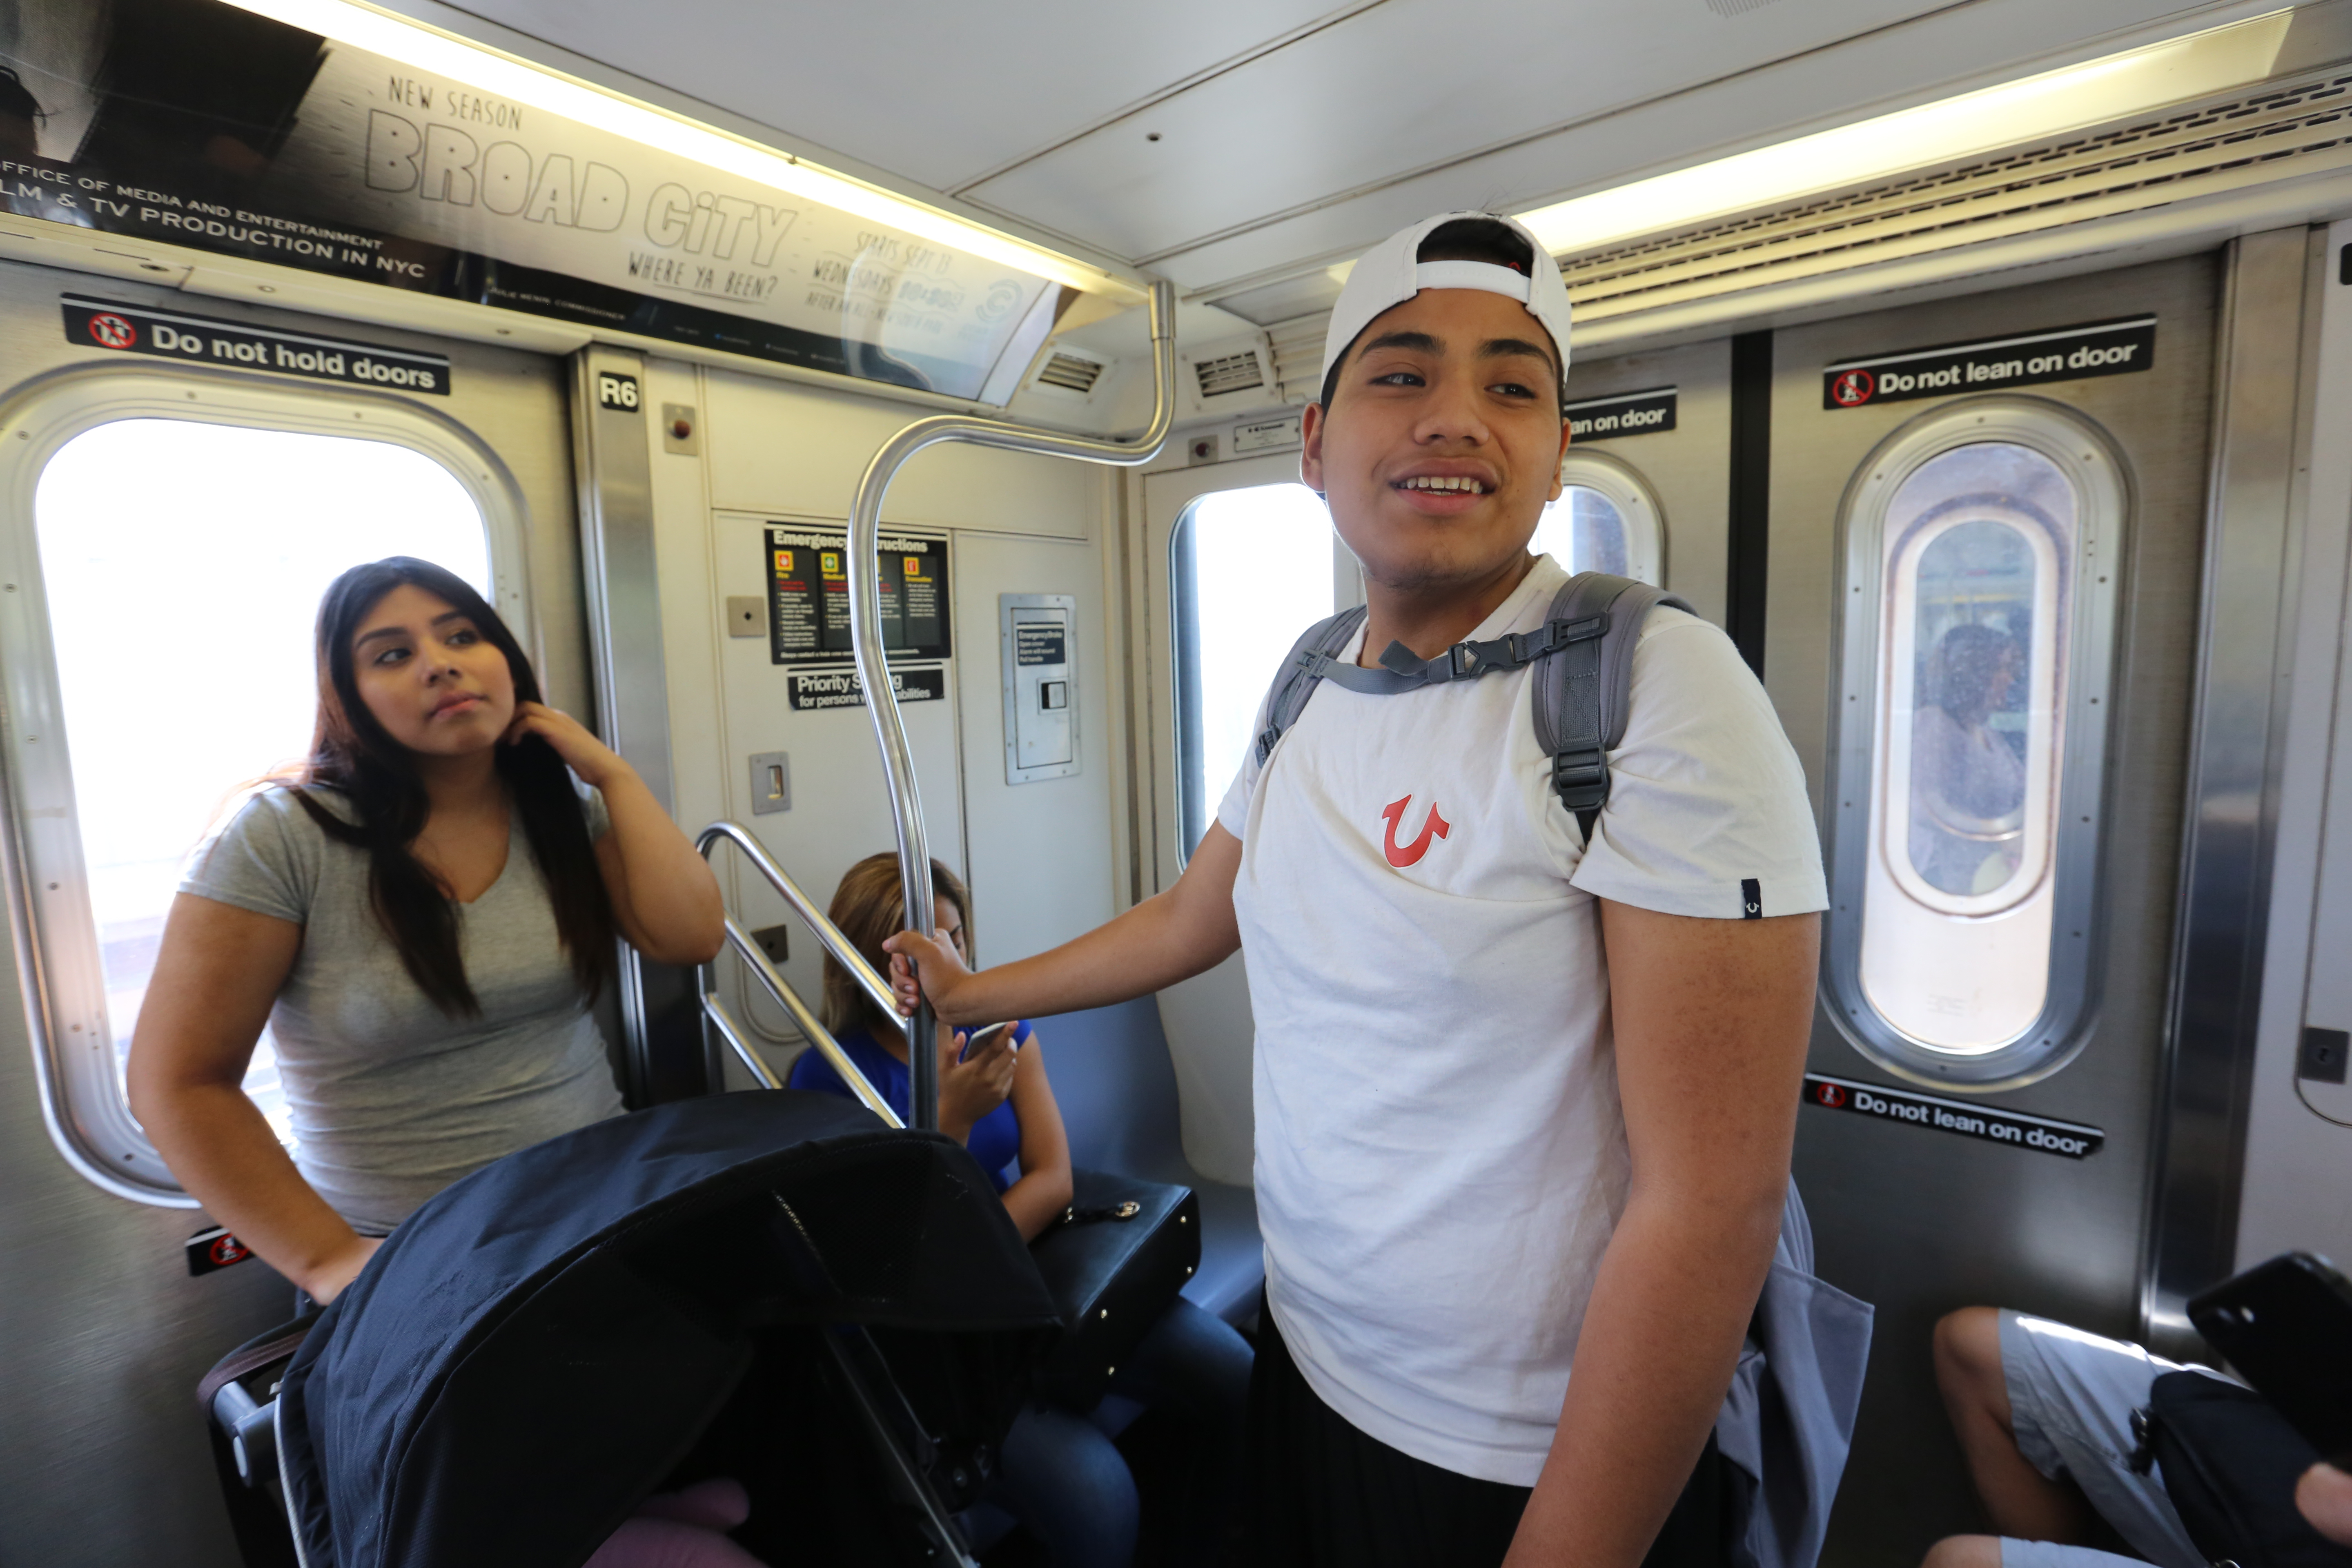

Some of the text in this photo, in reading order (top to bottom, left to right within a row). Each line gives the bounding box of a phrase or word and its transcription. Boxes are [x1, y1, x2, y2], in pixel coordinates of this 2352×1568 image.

[389, 75, 523, 131] NEW SEASON
[365, 108, 629, 232] BROAD
[0, 160, 384, 250] FFICE OF MEDIA AND ENTERTAINMENT
[56, 192, 78, 209] &
[89, 196, 130, 218] TV
[140, 207, 333, 259] PRODUCTION
[342, 248, 368, 266] IN
[376, 256, 425, 278] NYC
[628, 251, 779, 300] WHERE YA BEEN?
[152, 325, 435, 388] Do not hold doors
[1879, 344, 2138, 394] Do not lean on door
[599, 376, 638, 407] R6
[1571, 408, 1667, 435] an on door
[797, 675, 851, 693] Priority
[798, 695, 816, 708] for
[817, 694, 858, 709] persons
[1855, 1091, 2088, 1155] Do not lean on door
